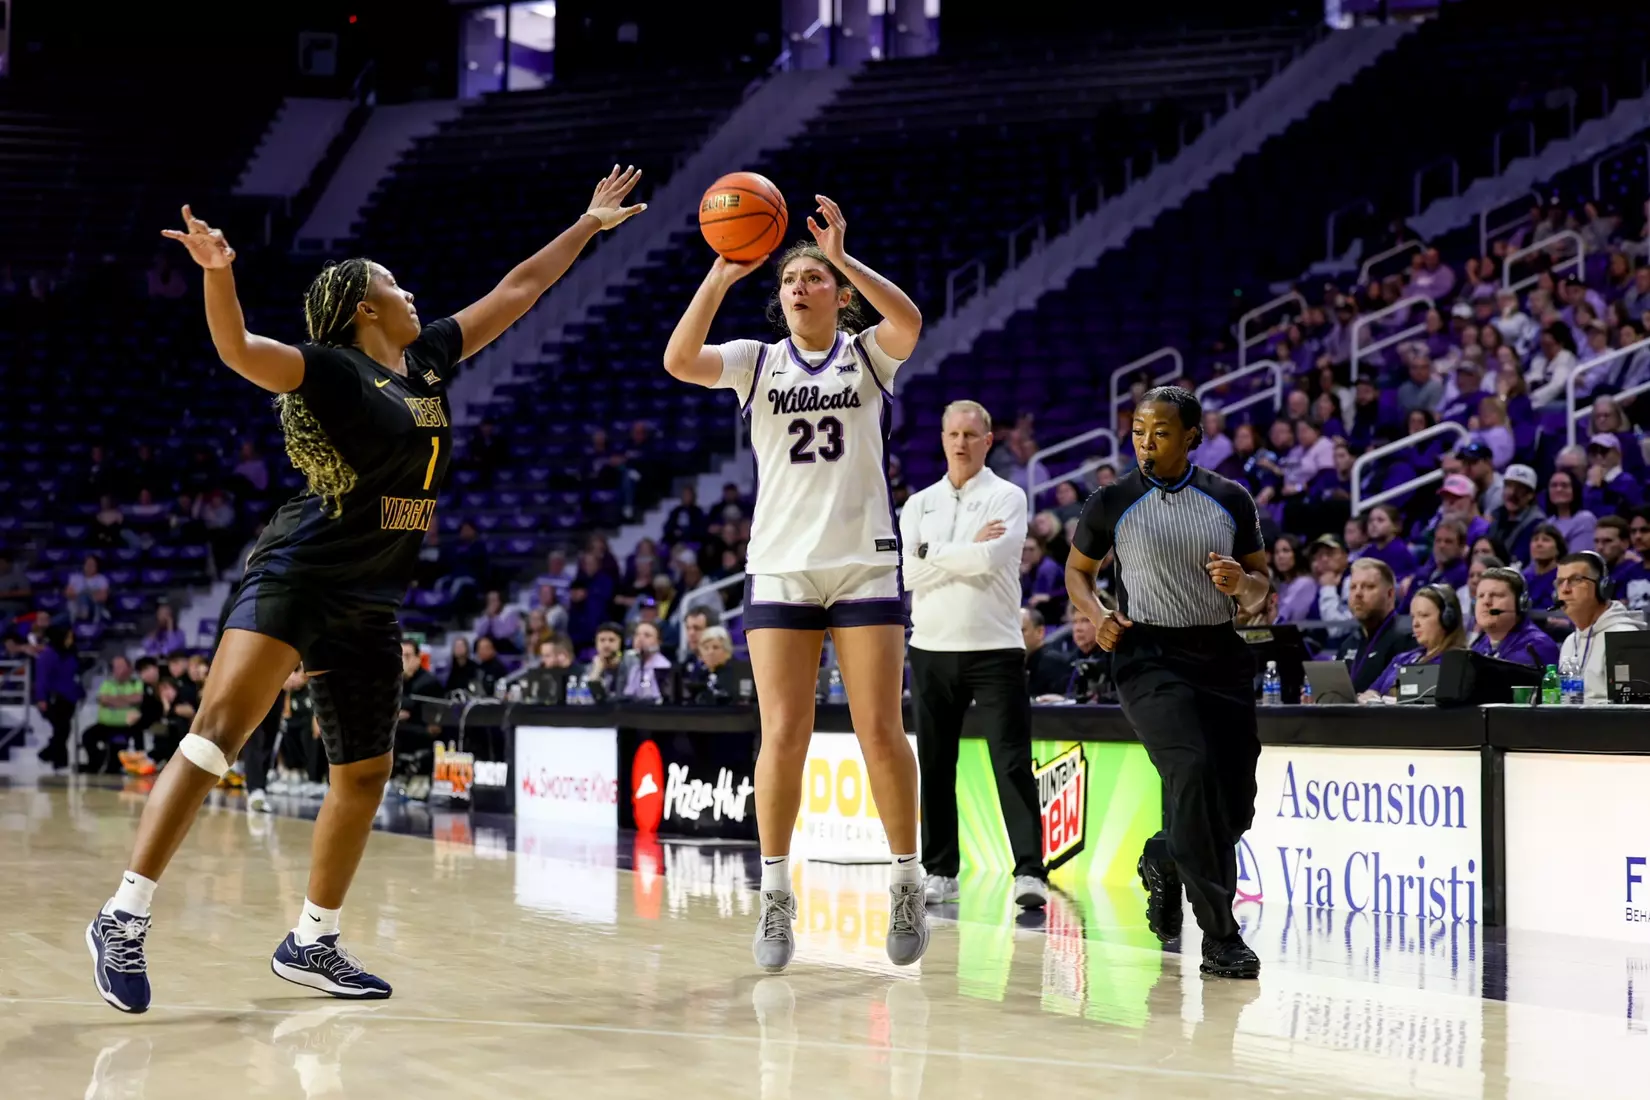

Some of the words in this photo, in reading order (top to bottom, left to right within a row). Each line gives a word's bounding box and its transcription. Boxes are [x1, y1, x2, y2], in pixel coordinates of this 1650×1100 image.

[404, 397, 448, 427] WEST
[768, 385, 861, 415] Wildcats
[423, 436, 439, 490] 1
[788, 415, 845, 464] 23
[712, 766, 754, 822] Hut
[1276, 761, 1467, 828] Ascension
[1276, 846, 1335, 908] Via
[1344, 851, 1478, 923] Christi
